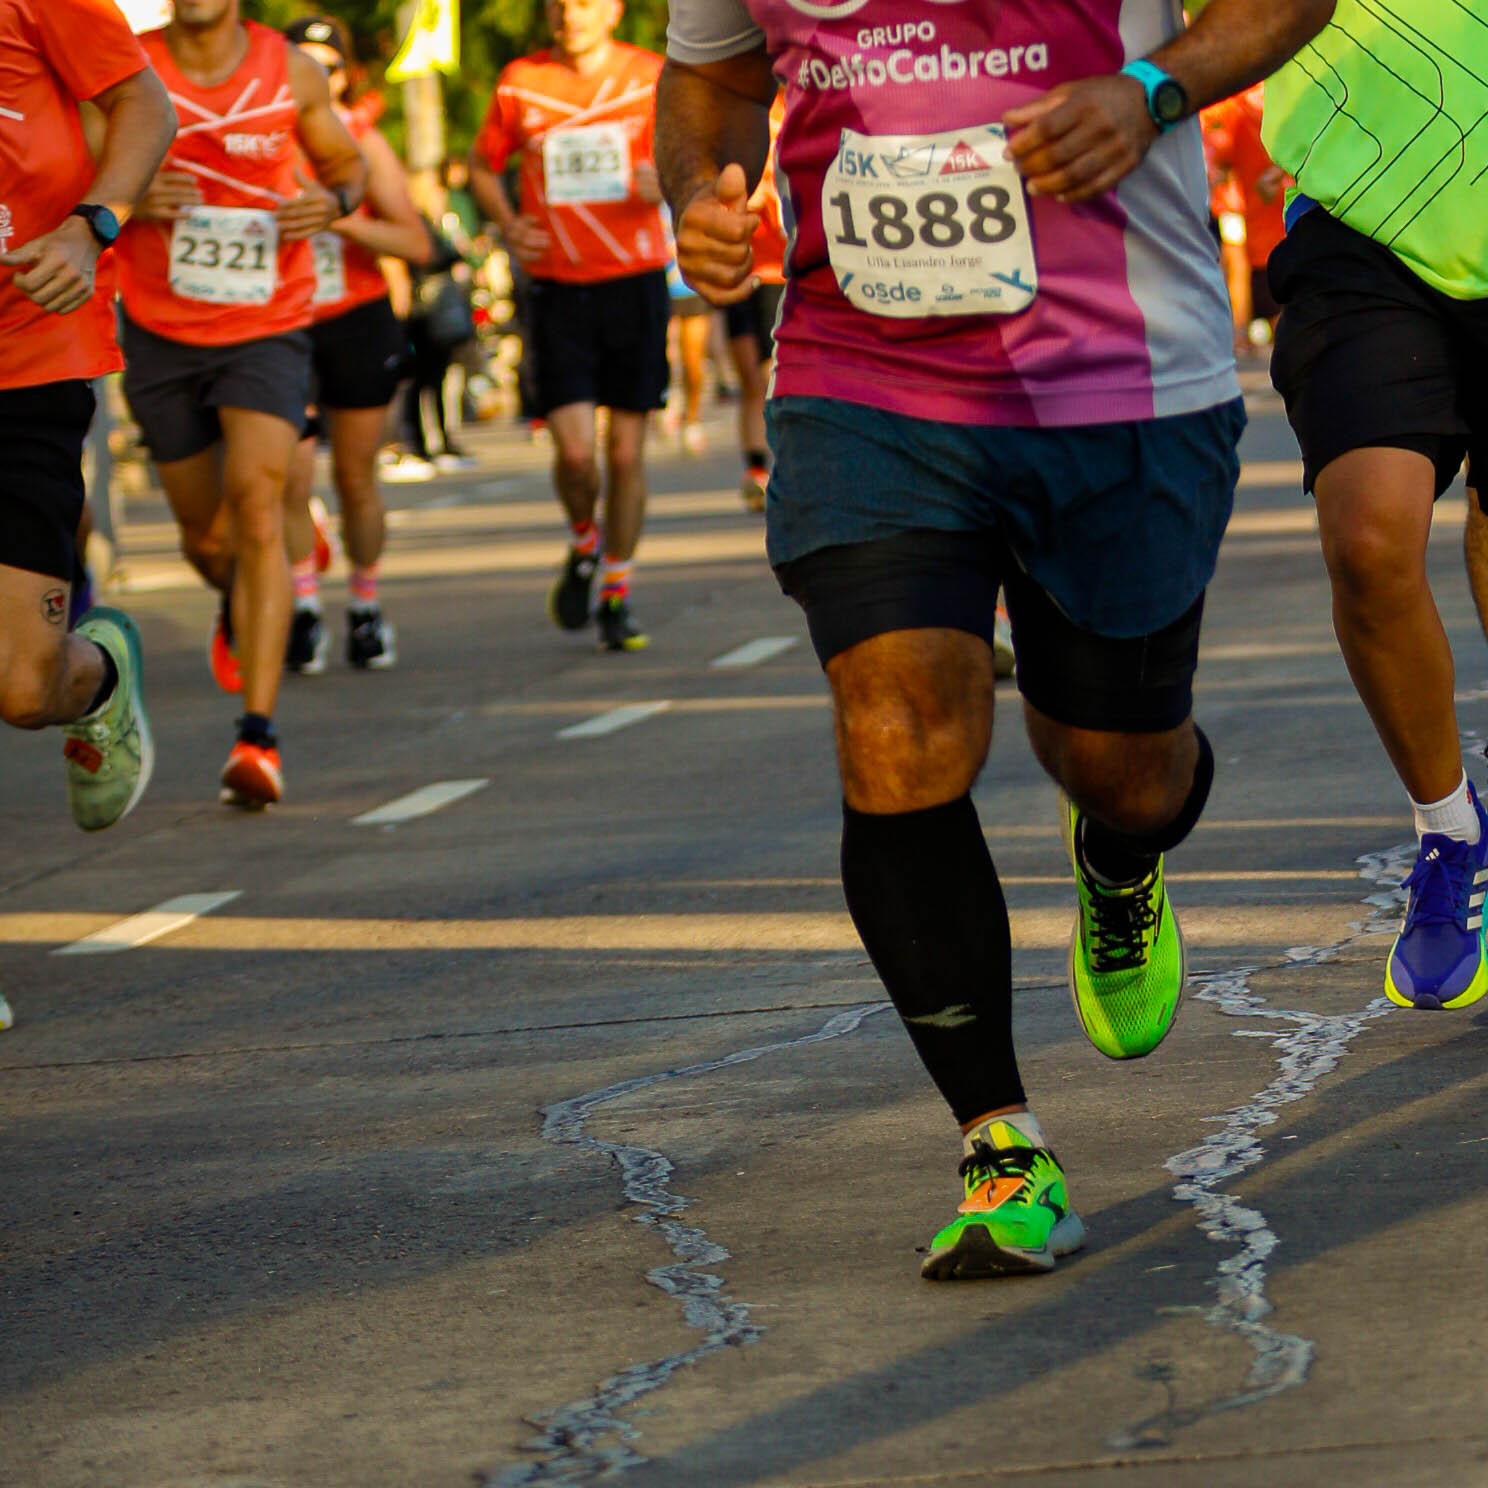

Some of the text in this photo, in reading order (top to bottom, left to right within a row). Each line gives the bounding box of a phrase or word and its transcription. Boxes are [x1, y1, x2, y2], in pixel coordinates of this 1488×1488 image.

[857, 21, 936, 49] GRUPO
[797, 43, 1049, 91] #DelfoCabrera
[829, 185, 1017, 251] 1888
[177, 236, 268, 271] 2321
[861, 281, 922, 304] osde
